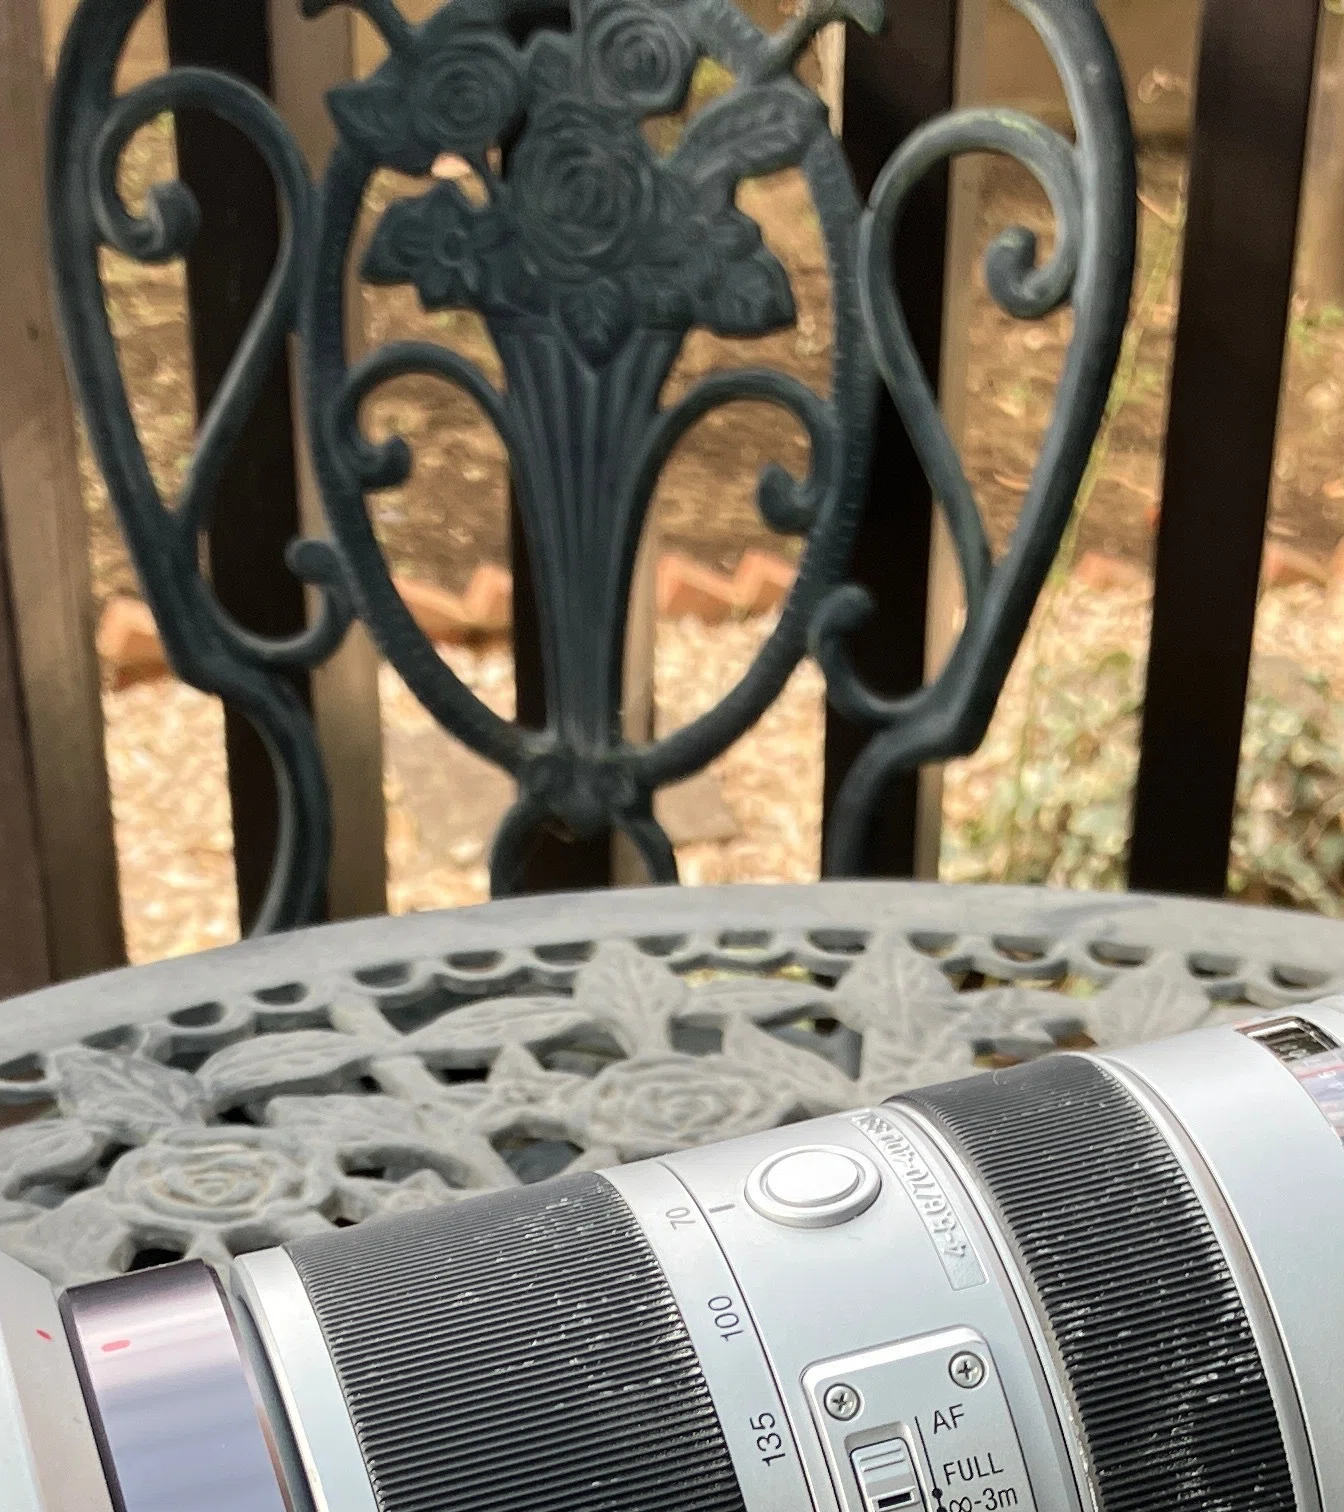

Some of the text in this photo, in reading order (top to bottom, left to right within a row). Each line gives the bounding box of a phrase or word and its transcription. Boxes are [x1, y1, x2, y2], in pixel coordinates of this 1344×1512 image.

[665, 1206, 697, 1230] 70
[707, 1295, 745, 1341] 100
[932, 1404, 965, 1434] AF
[750, 1412, 786, 1467] 135
[942, 1453, 1004, 1485] FULL
